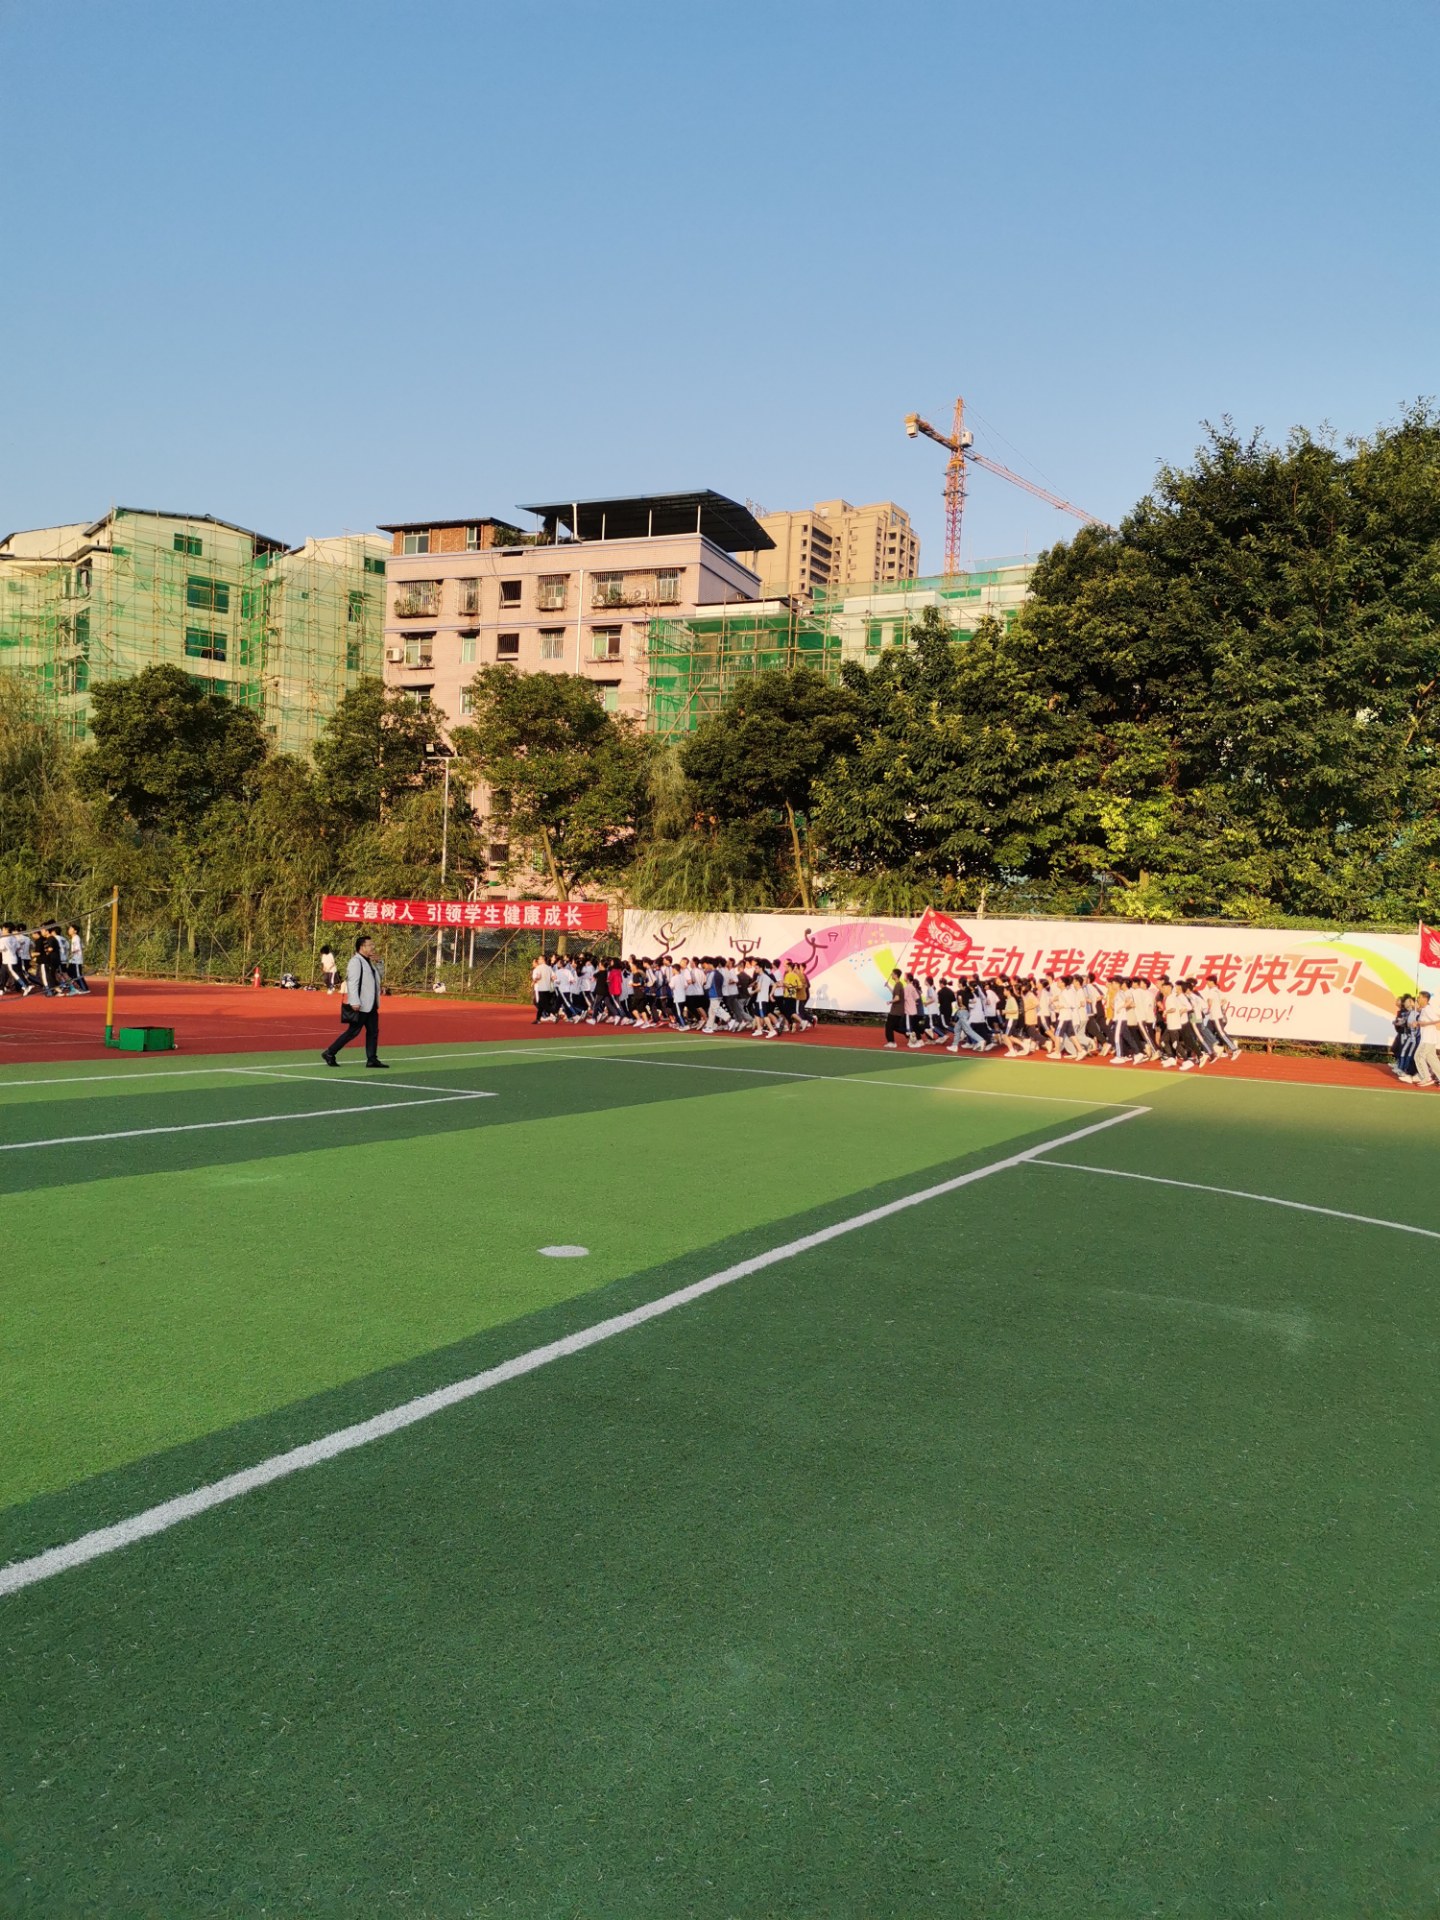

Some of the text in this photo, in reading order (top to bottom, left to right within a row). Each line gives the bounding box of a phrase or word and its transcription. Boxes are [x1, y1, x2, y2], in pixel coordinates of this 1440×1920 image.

[345, 900, 582, 926] 立德树人 引领学生健康成长
[1224, 1001, 1294, 1024] happy!
